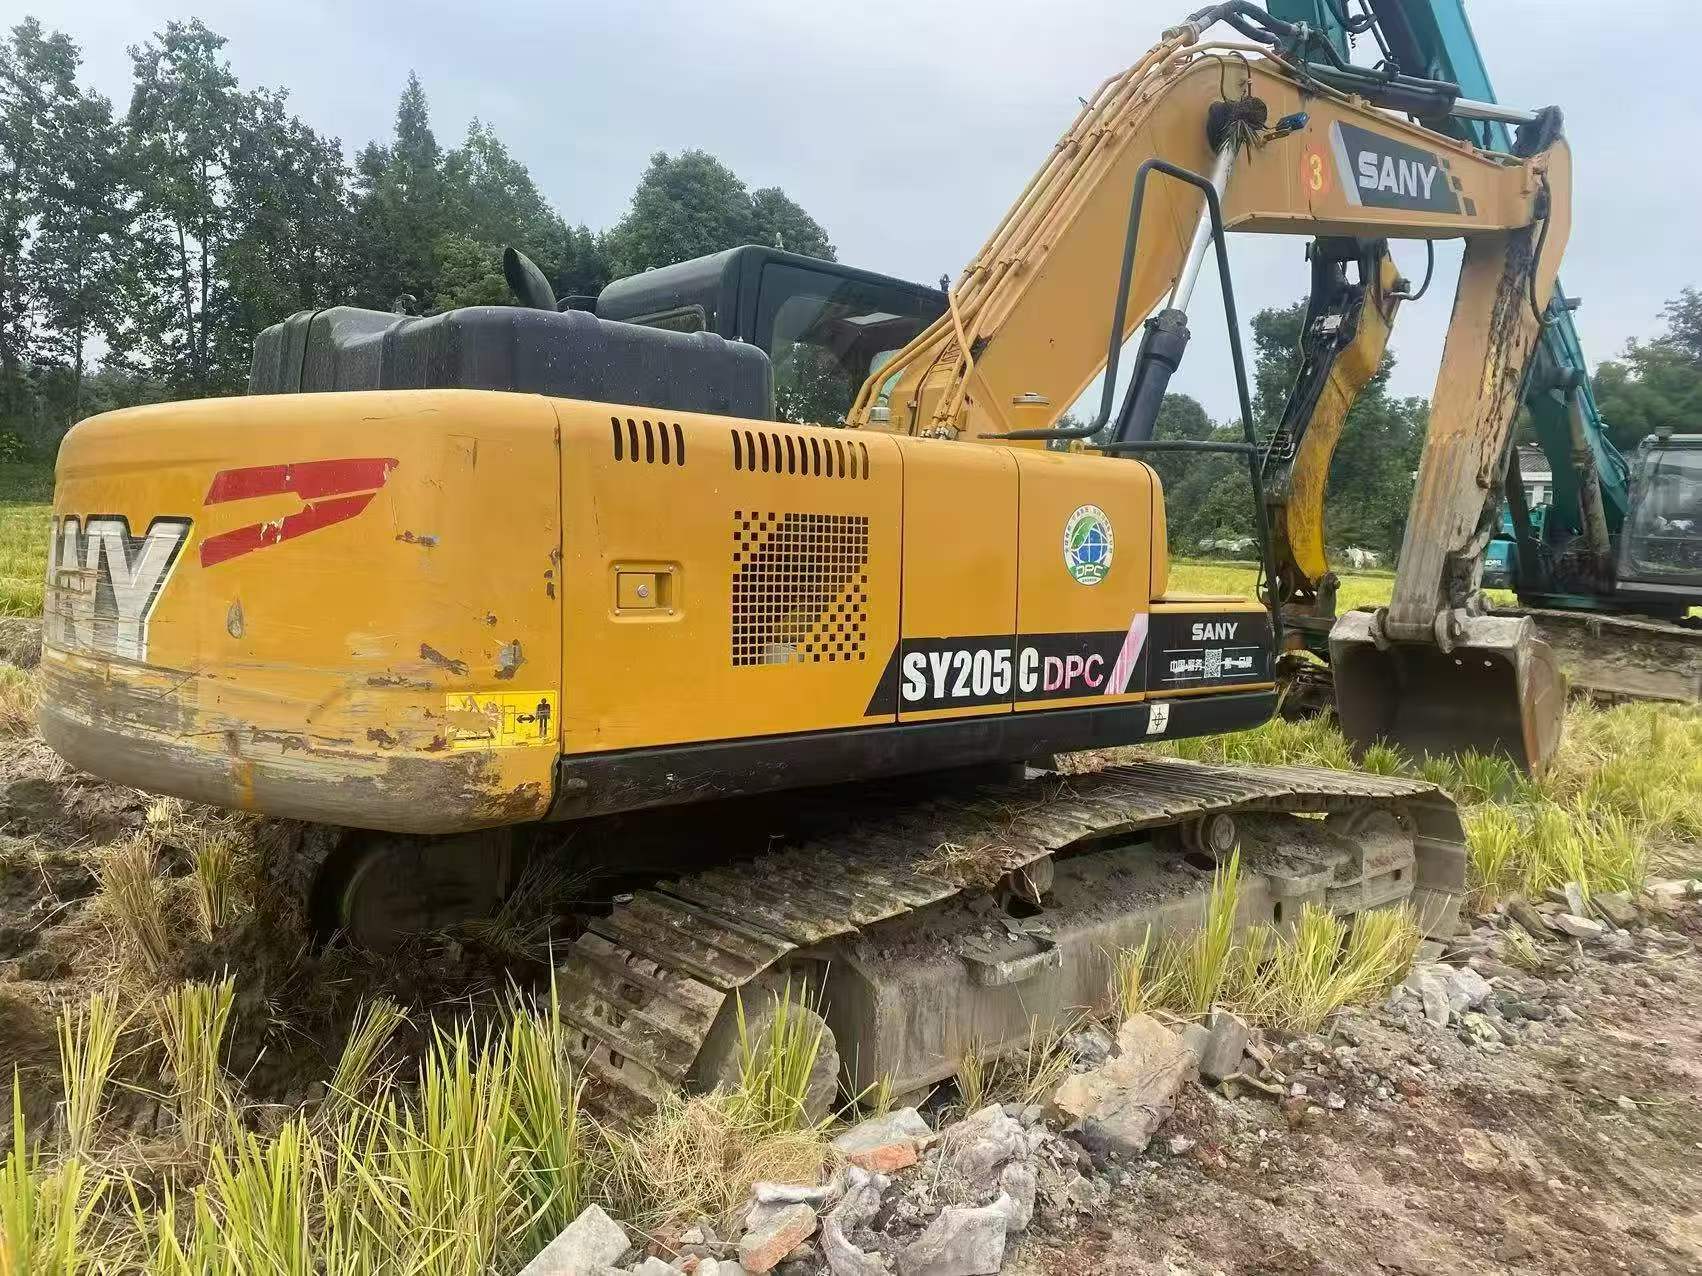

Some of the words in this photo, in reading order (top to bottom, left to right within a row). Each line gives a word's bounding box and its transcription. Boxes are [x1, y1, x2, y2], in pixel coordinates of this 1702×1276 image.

[1309, 153, 1323, 191] 3
[1358, 150, 1437, 200] SANY
[44, 514, 194, 663] NY
[1076, 564, 1104, 578] DPC
[1192, 622, 1239, 641] SANY
[1043, 653, 1105, 692] DPC
